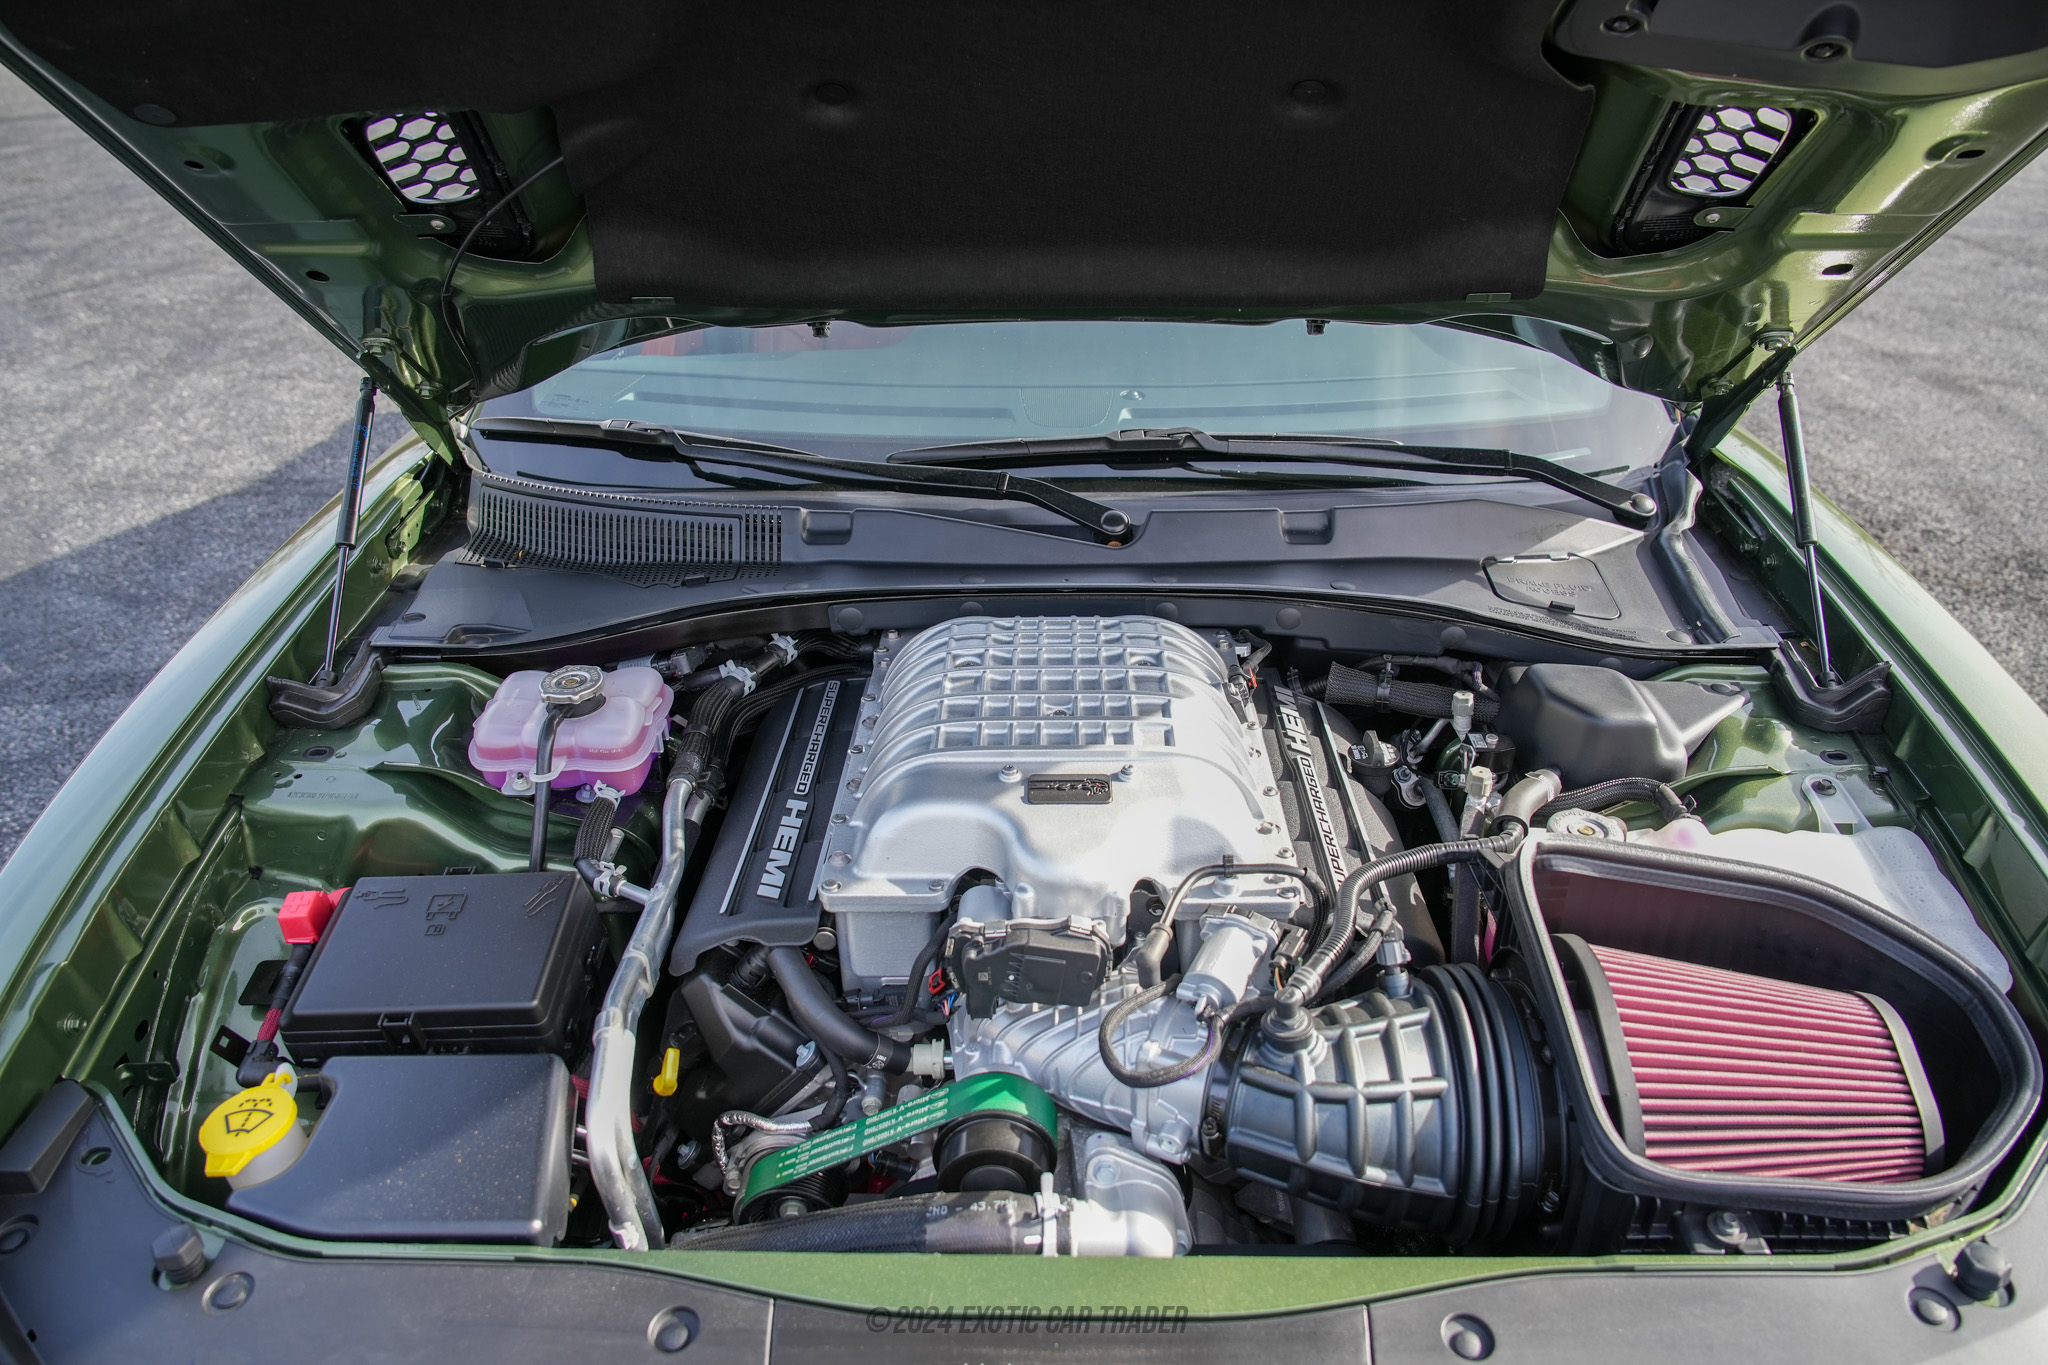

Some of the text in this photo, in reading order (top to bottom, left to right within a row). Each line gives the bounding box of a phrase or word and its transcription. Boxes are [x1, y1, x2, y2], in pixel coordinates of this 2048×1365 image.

[1553, 582, 1590, 591] FLUID
[795, 681, 838, 793] SUPERCHARGED
[1274, 685, 1311, 756] HEMI
[757, 799, 807, 899] HEMI
[1300, 757, 1347, 887] UPERCHARGED
